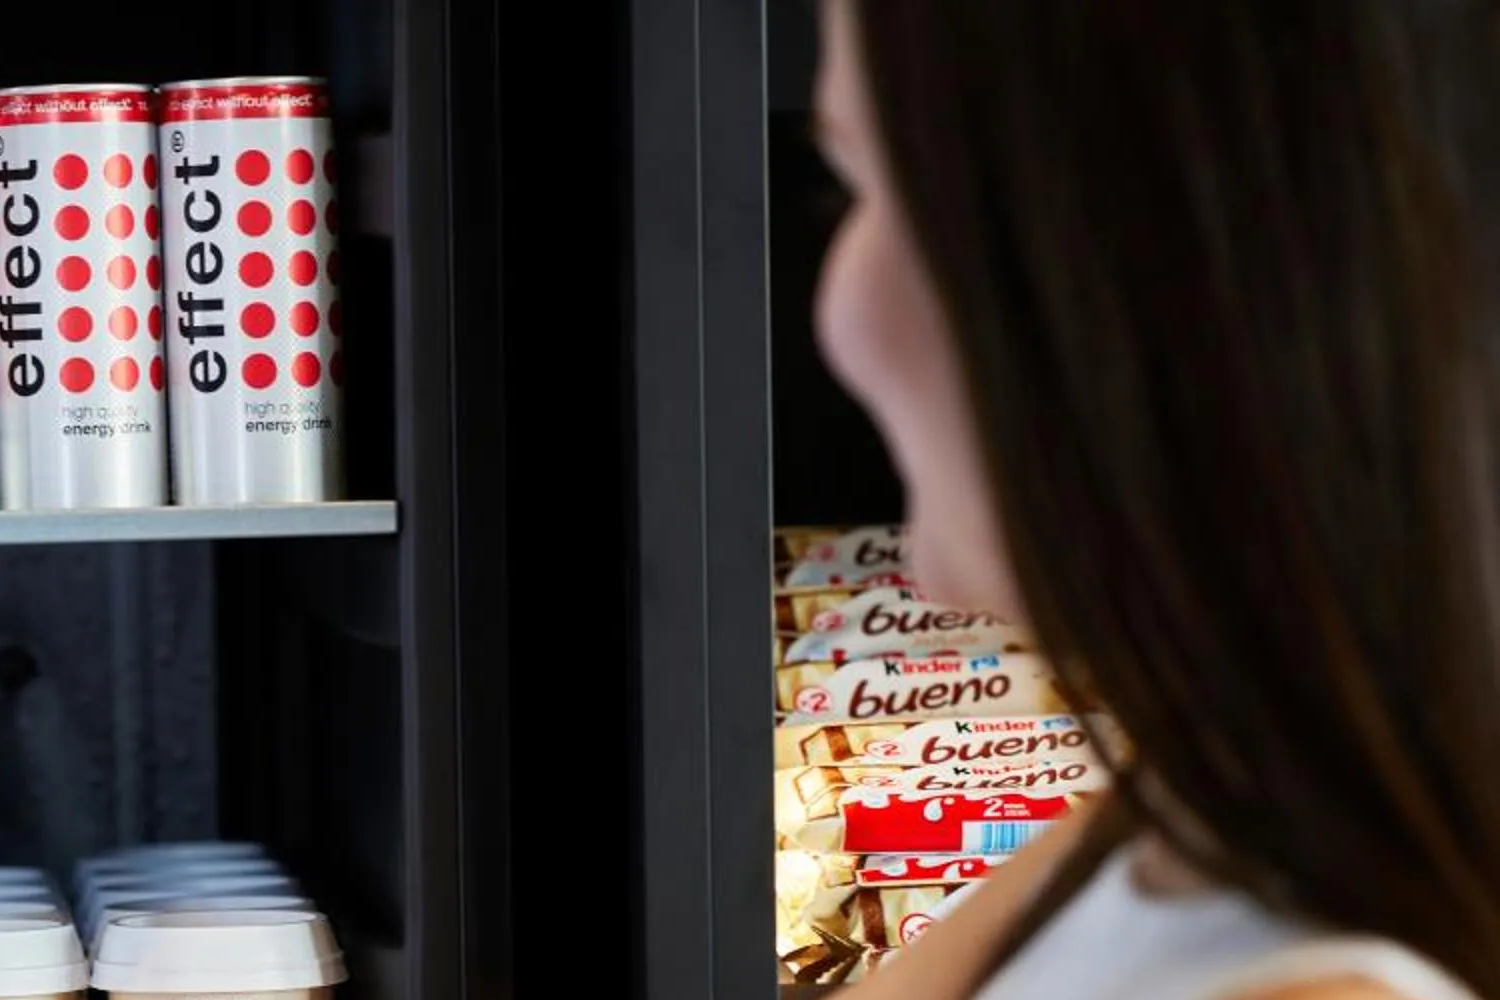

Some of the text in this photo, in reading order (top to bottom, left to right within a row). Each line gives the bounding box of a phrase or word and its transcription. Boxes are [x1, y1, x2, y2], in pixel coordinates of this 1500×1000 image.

[63, 424, 115, 438] energy
[245, 420, 297, 436] energy
[848, 674, 1011, 719] bueno
[921, 730, 1087, 765] bueno
[983, 797, 1004, 817] 2
